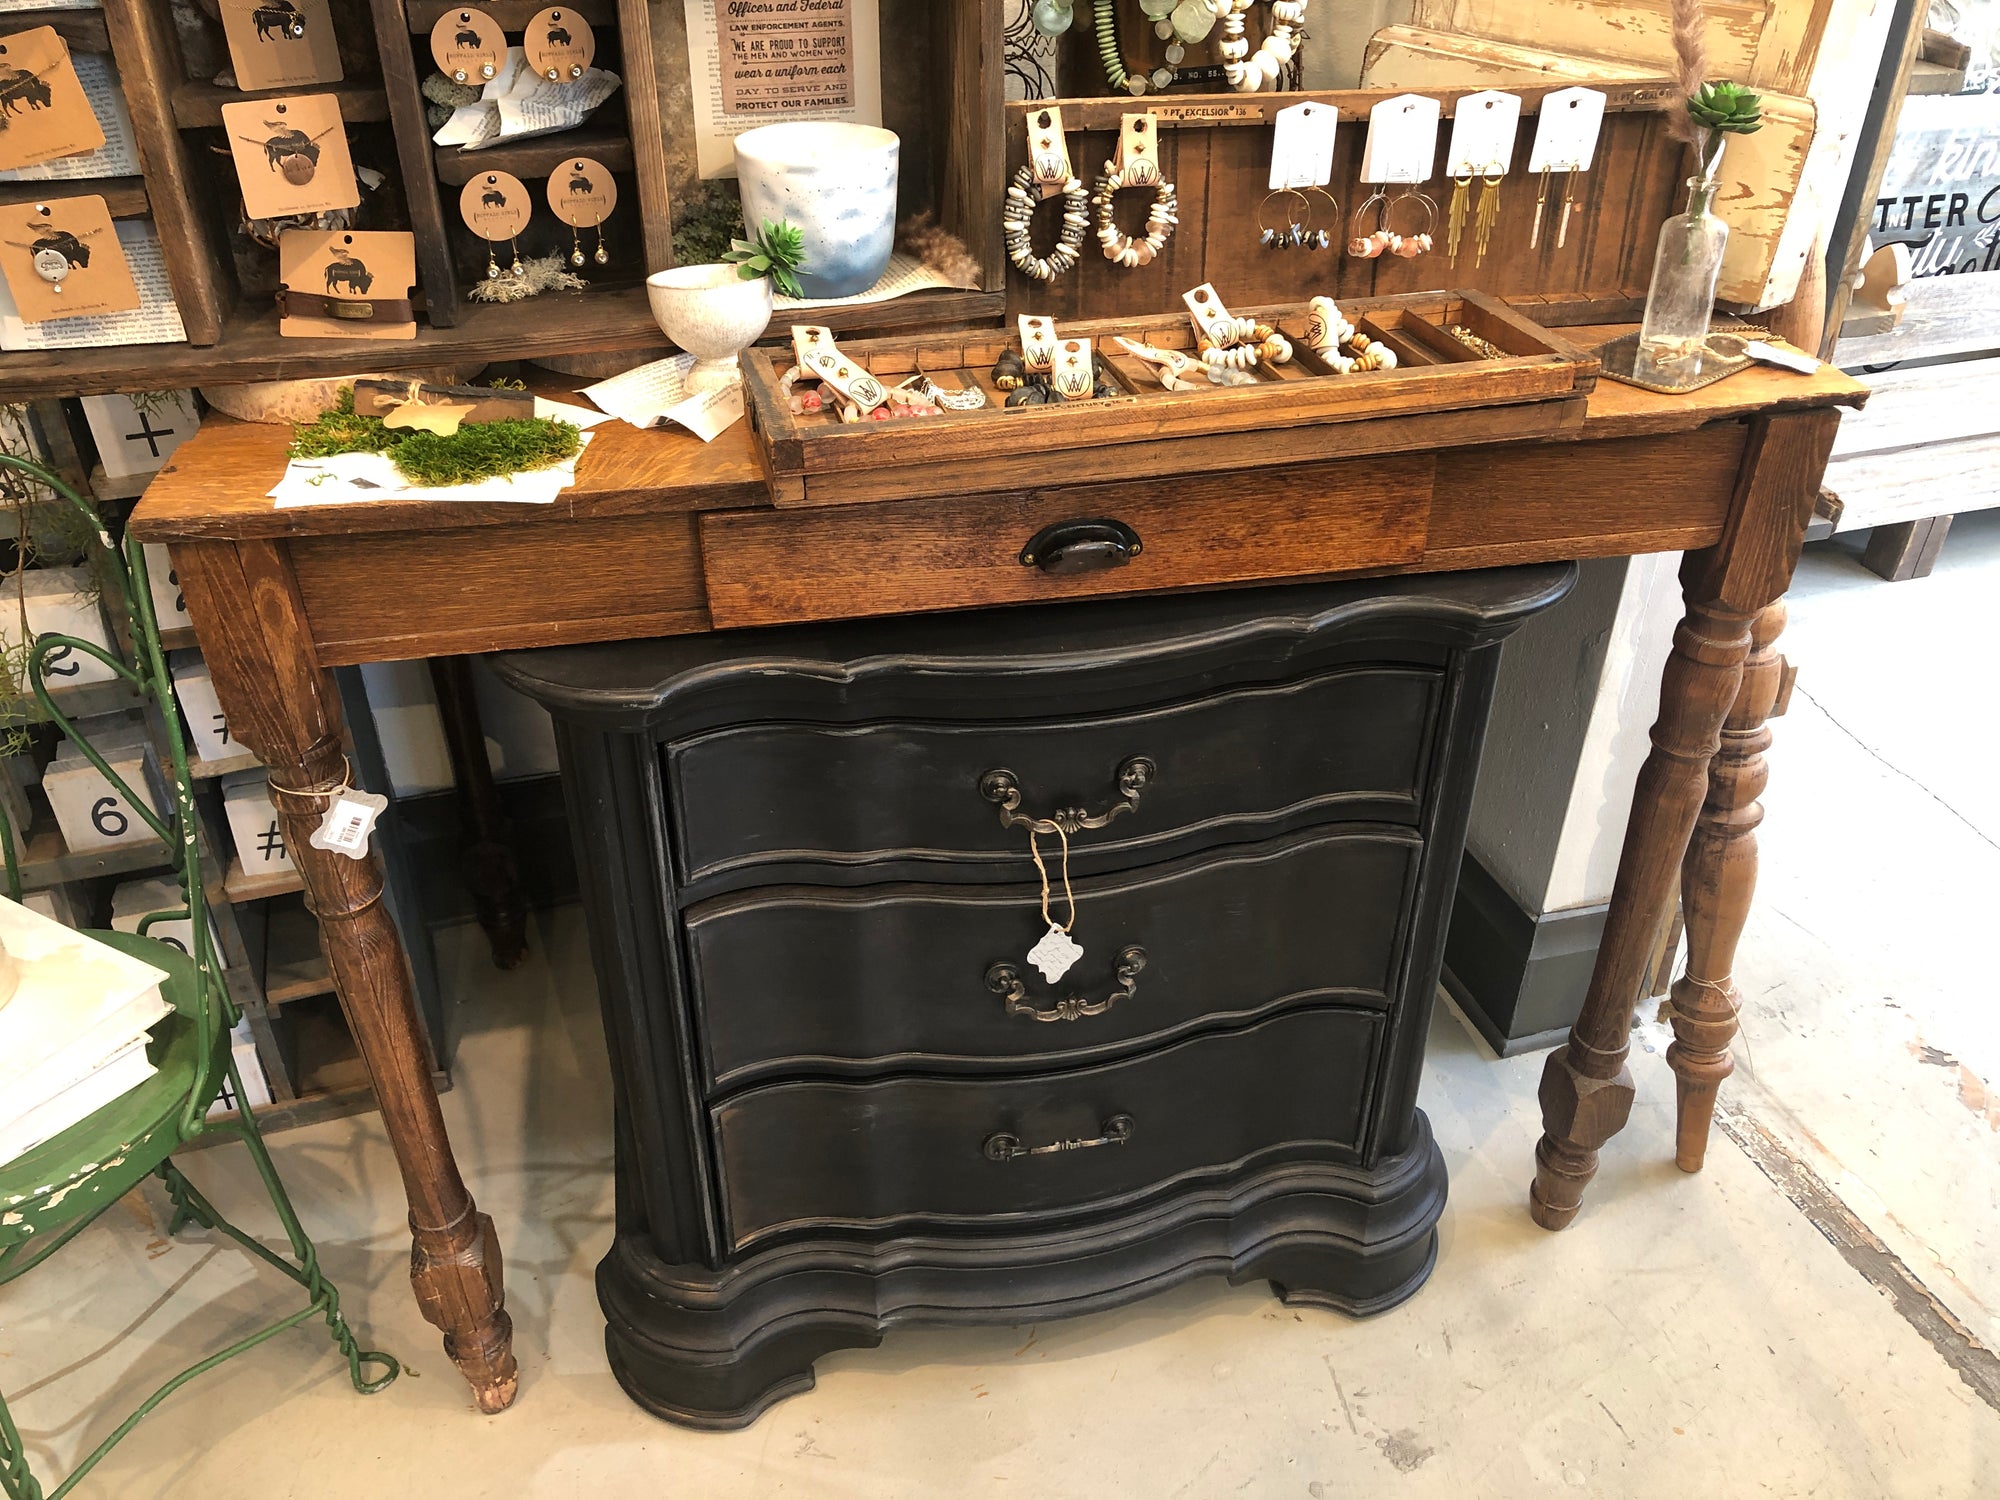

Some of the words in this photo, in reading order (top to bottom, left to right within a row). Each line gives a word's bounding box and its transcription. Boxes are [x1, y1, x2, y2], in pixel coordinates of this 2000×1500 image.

[727, 0, 774, 17] Officers
[776, 2, 798, 12] and
[801, 0, 844, 11] Federal
[751, 22, 809, 31] ENFORCEMENT
[812, 20, 845, 28] AGENTS.
[731, 39, 746, 51] WE
[751, 39, 764, 51] ARE
[770, 38, 793, 50] PROUD
[798, 38, 808, 49] TO
[813, 36, 845, 48] SUPPORT
[771, 51, 787, 59] AND
[825, 48, 846, 56] WHO
[734, 68, 763, 79] wear
[765, 69, 772, 77] a
[775, 65, 819, 80] uniform
[821, 63, 847, 74] each
[782, 85, 820, 93] SERVE
[735, 100, 778, 110] PROTECT
[804, 97, 849, 106] FAMILIES.
[1185, 107, 1229, 116] EXCELSIOR
[1236, 108, 1246, 116] 136
[91, 796, 129, 837] 6
